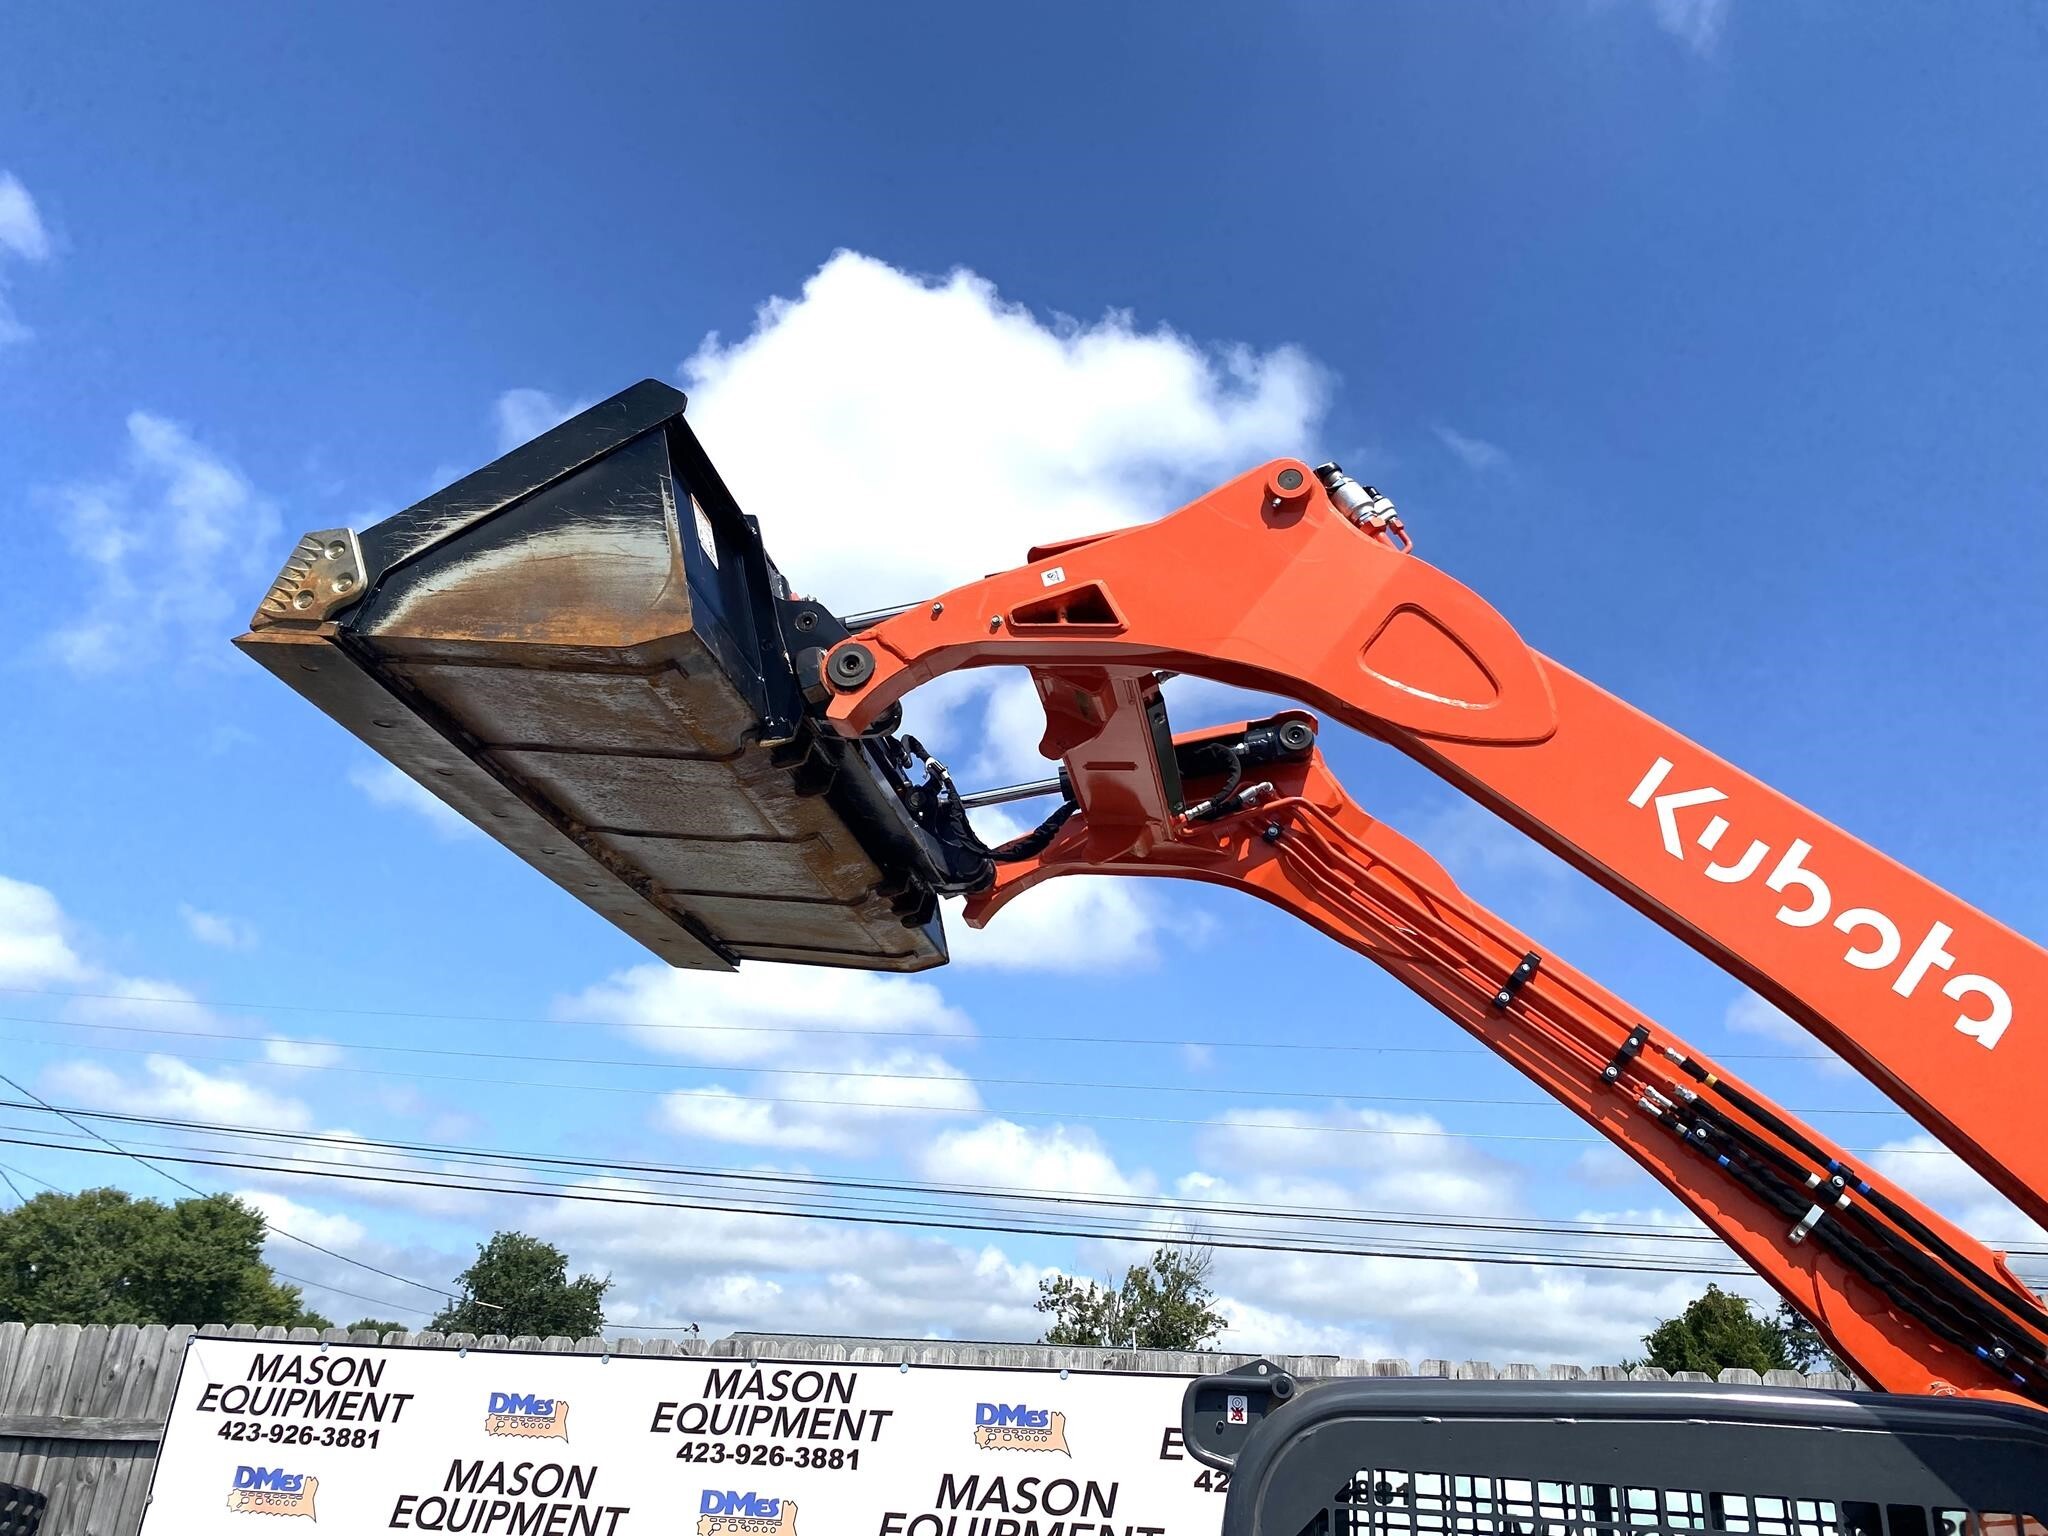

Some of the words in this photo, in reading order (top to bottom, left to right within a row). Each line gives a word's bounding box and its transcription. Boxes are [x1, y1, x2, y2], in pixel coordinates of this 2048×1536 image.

[1628, 757, 2013, 1050] Kubota
[247, 1353, 386, 1388] MASON
[702, 1368, 857, 1404] MASON
[196, 1383, 414, 1424] EQUIPMENT
[650, 1401, 893, 1442] EQUIPMENT
[217, 1420, 380, 1450] 423-926-3881
[676, 1441, 859, 1471] 423-926-3881
[443, 1459, 598, 1500] MASON
[935, 1473, 1119, 1519] MASON
[388, 1494, 631, 1536] EQUIPMENT
